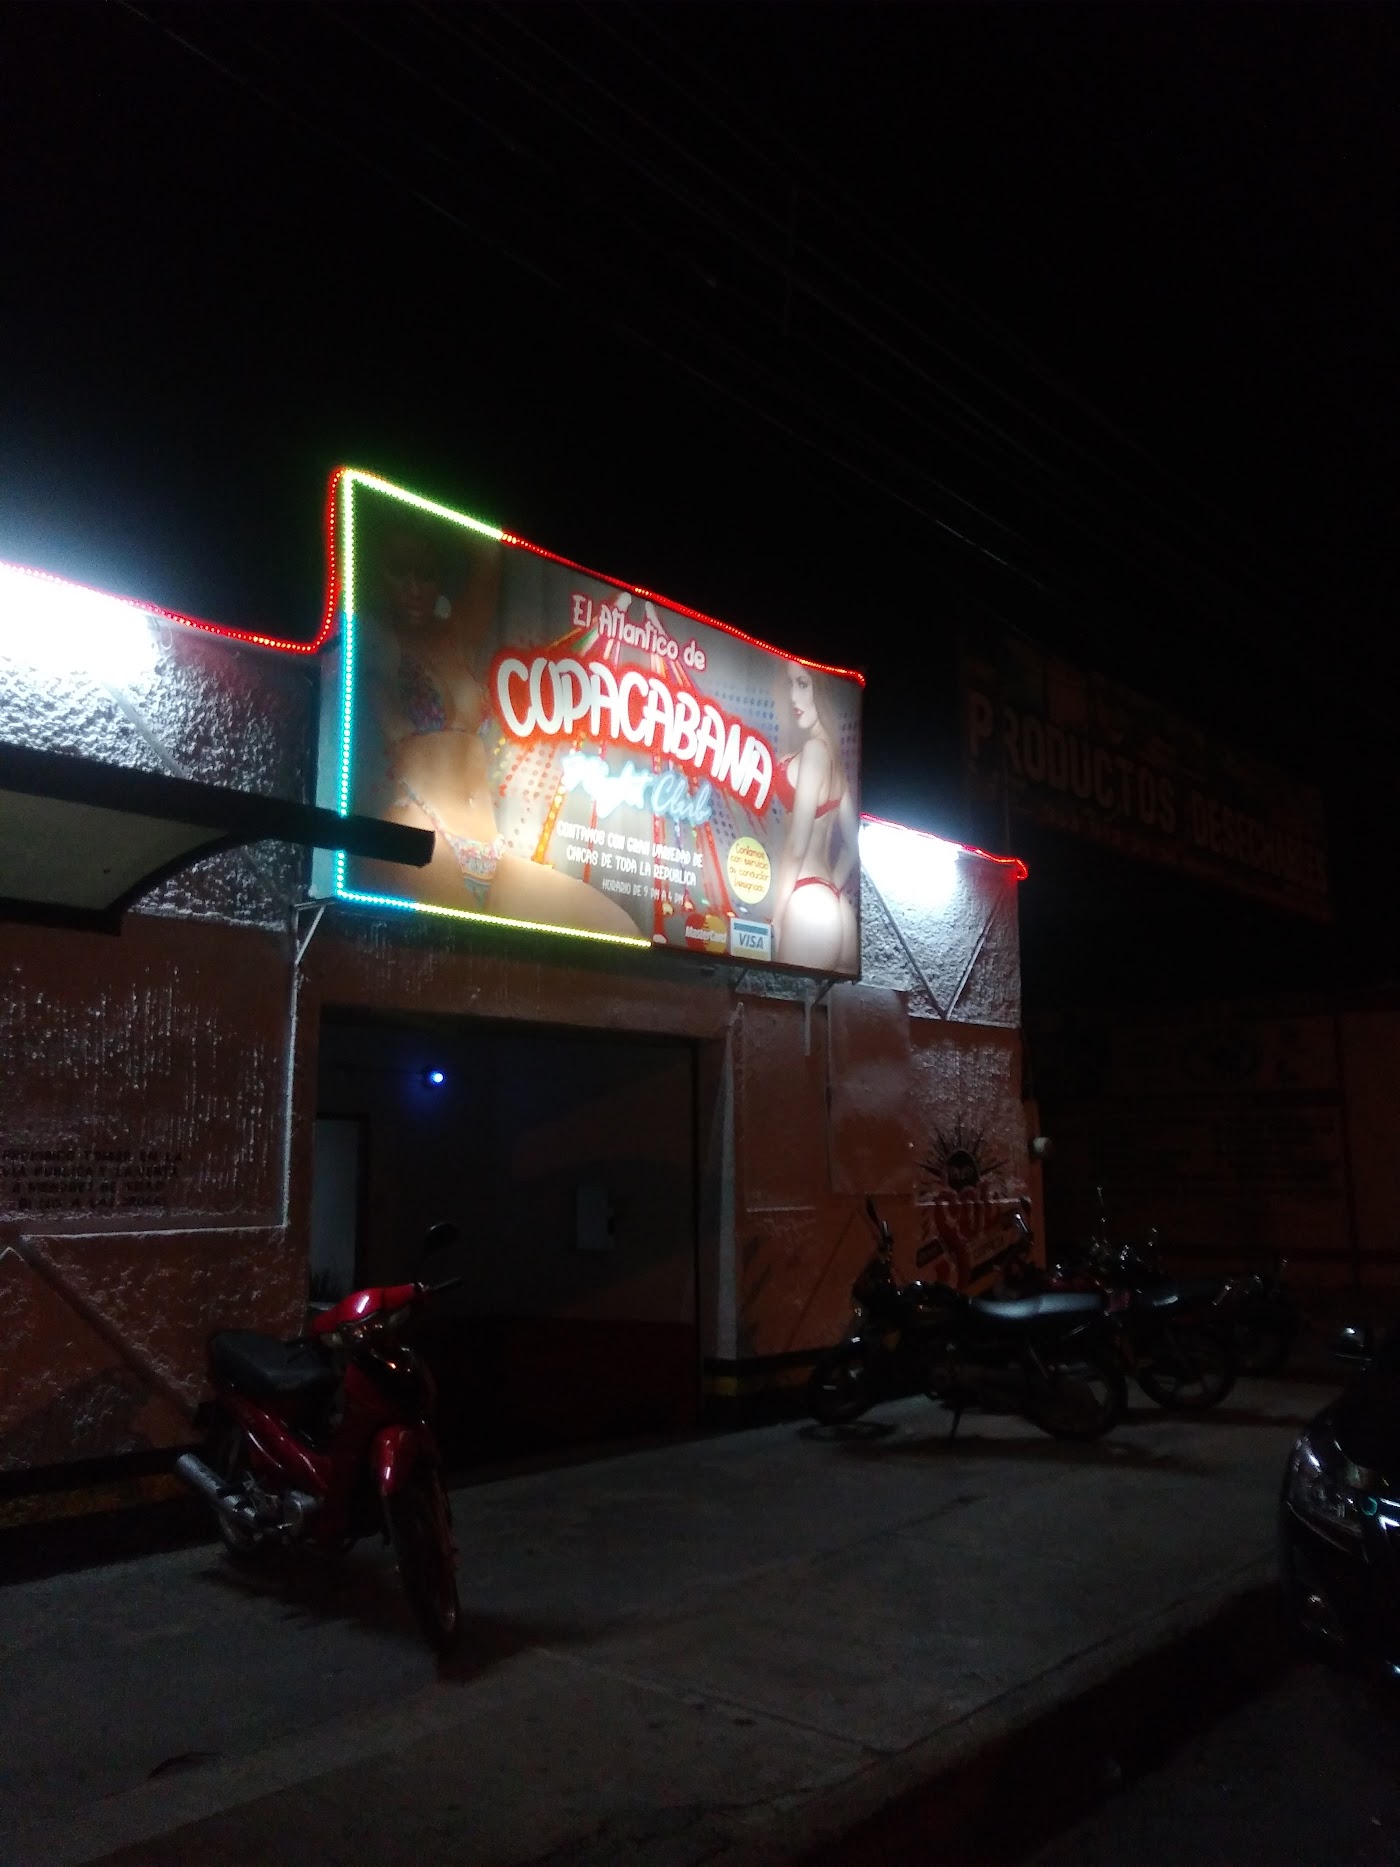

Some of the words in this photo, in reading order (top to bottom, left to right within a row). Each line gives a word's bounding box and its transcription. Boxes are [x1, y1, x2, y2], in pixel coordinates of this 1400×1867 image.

[571, 593, 592, 627] El
[684, 640, 707, 672] de
[496, 656, 773, 810] COPACABANA
[966, 688, 1177, 836] PRODUCTOS
[651, 771, 712, 825] Club
[556, 820, 605, 846] CONTAMOS
[608, 832, 626, 850] CON
[627, 837, 651, 857] GRAN
[652, 843, 691, 865] VARIEDAD
[693, 853, 704, 868] DE
[566, 845, 598, 865] CHICAS
[601, 852, 612, 869] DE
[616, 855, 637, 874] TODA
[640, 861, 651, 877] LA
[653, 864, 697, 887] REPUBLICA
[602, 878, 631, 895] HORARIO
[633, 884, 642, 896] DE
[643, 886, 649, 897] 9
[661, 889, 667, 901] A
[739, 933, 764, 949] VISA
